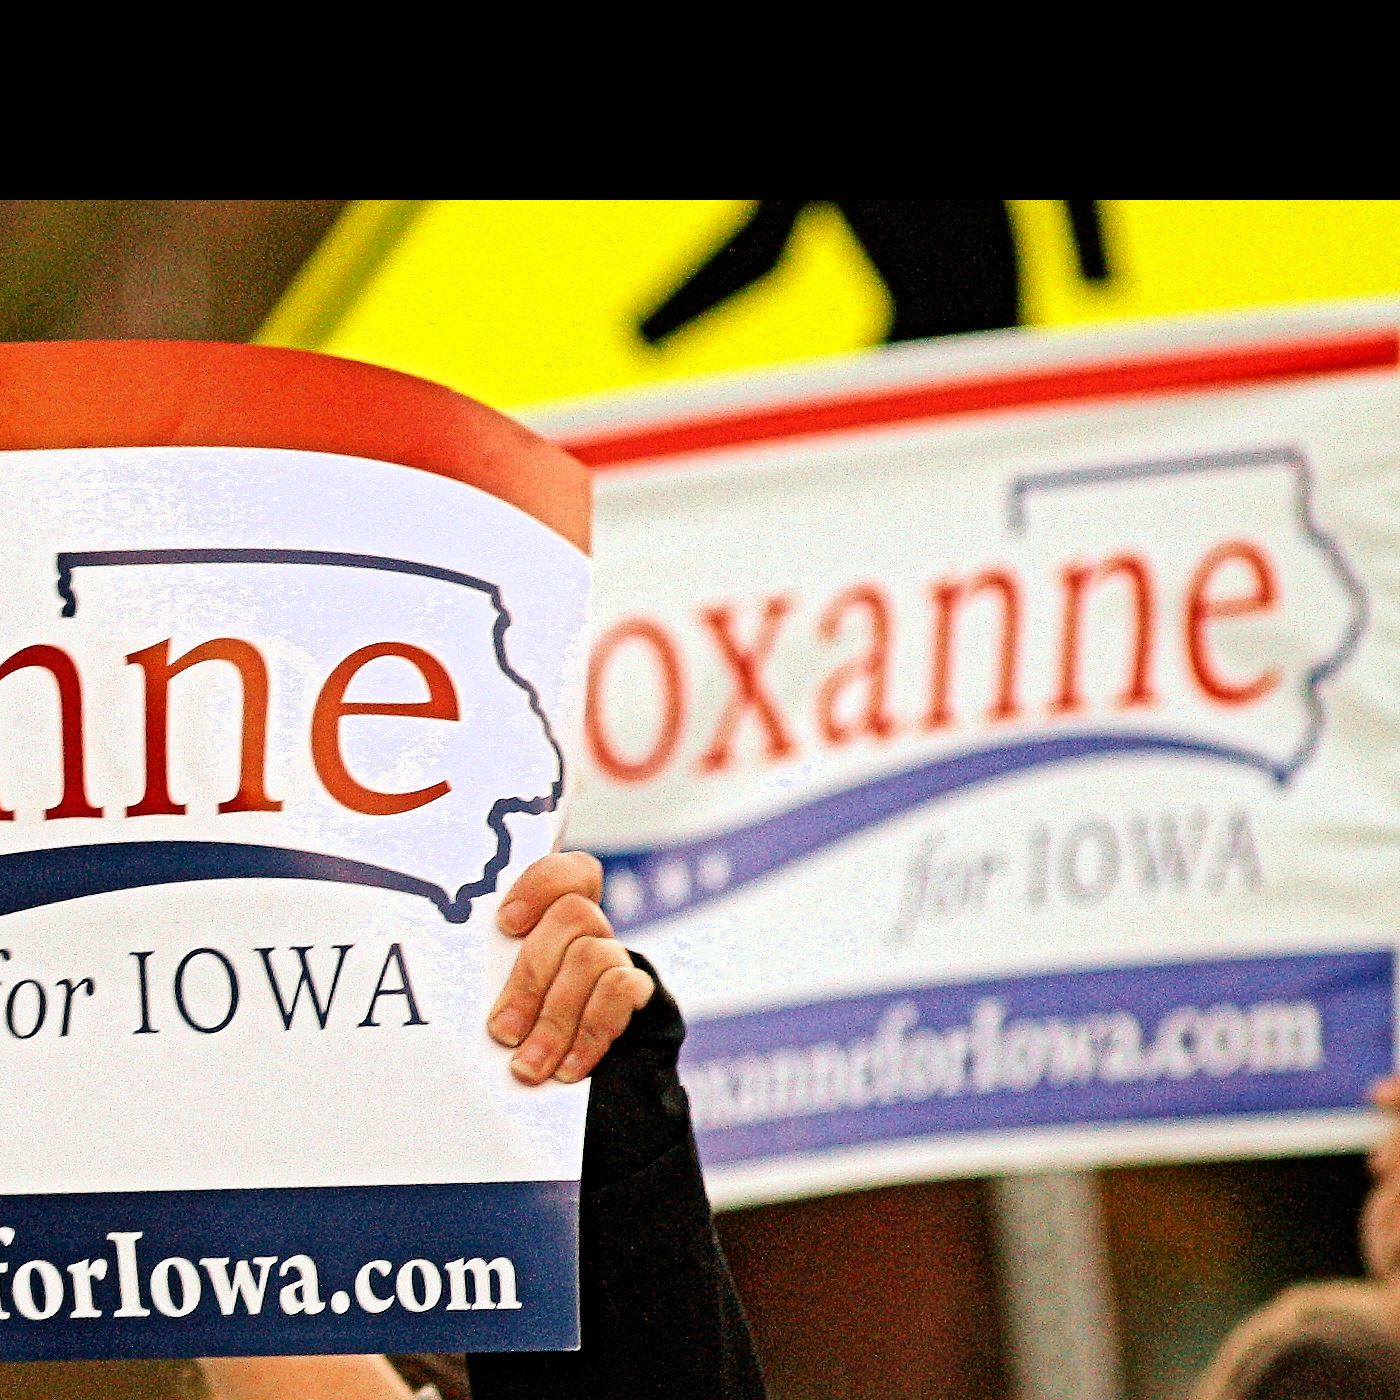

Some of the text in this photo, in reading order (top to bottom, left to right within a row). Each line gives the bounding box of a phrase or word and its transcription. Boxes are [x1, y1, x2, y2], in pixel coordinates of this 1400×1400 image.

[885, 806, 1266, 948] for IOWA
[129, 942, 430, 1036] IOWA
